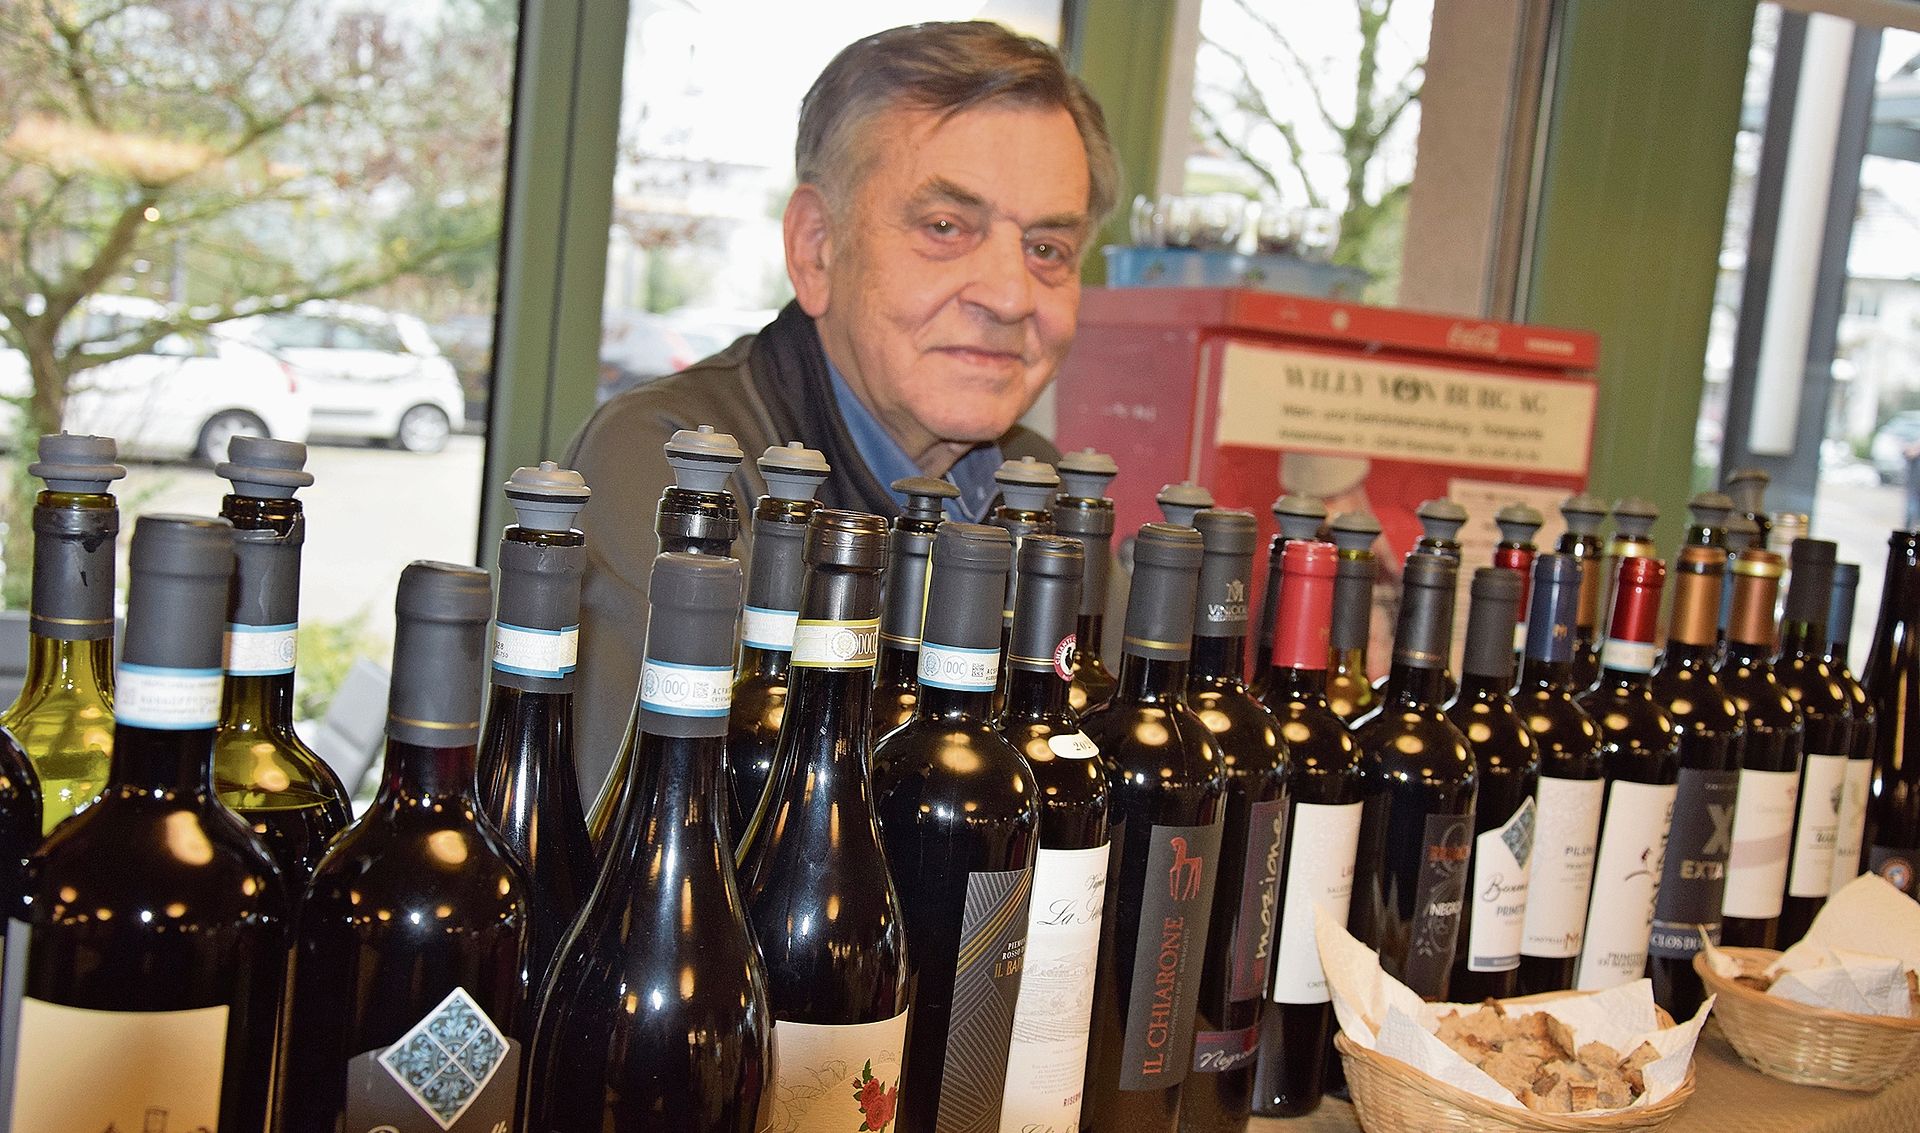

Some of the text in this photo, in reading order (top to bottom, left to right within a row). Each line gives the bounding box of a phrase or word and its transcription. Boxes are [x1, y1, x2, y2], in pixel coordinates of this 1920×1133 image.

[1283, 366, 1548, 416] WILLY VON BURG AG
[945, 661, 966, 675] DOC
[664, 679, 687, 696] DOC
[1036, 898, 1078, 926] La
[1147, 916, 1184, 1049] CHIARONE
[1142, 1052, 1164, 1075] IL
